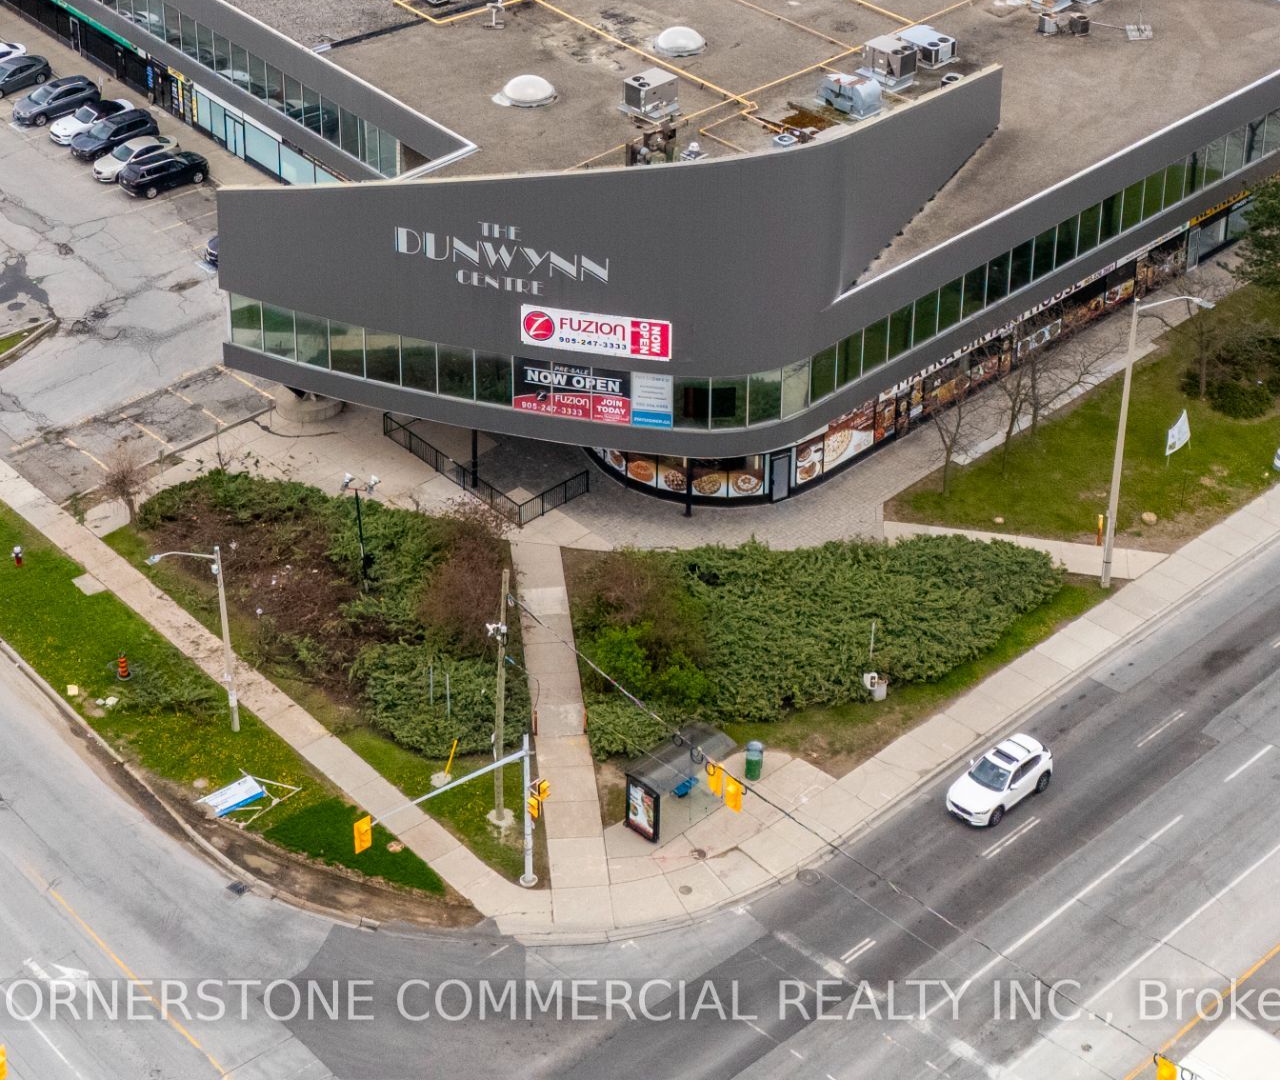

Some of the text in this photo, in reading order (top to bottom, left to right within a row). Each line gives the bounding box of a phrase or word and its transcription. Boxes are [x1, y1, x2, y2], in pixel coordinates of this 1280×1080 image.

[477, 221, 522, 241] THE
[394, 225, 610, 285] DUNWYNN
[455, 269, 545, 297] CENTRE
[558, 336, 628, 351] 905-247-3333
[639, 322, 650, 355] OPEN
[651, 325, 662, 354] NOW
[526, 370, 568, 386] NOW
[571, 375, 622, 393] OPEN
[521, 401, 584, 417] 905-247-3333
[595, 405, 626, 415] TODAY
[600, 398, 623, 408] JOIN
